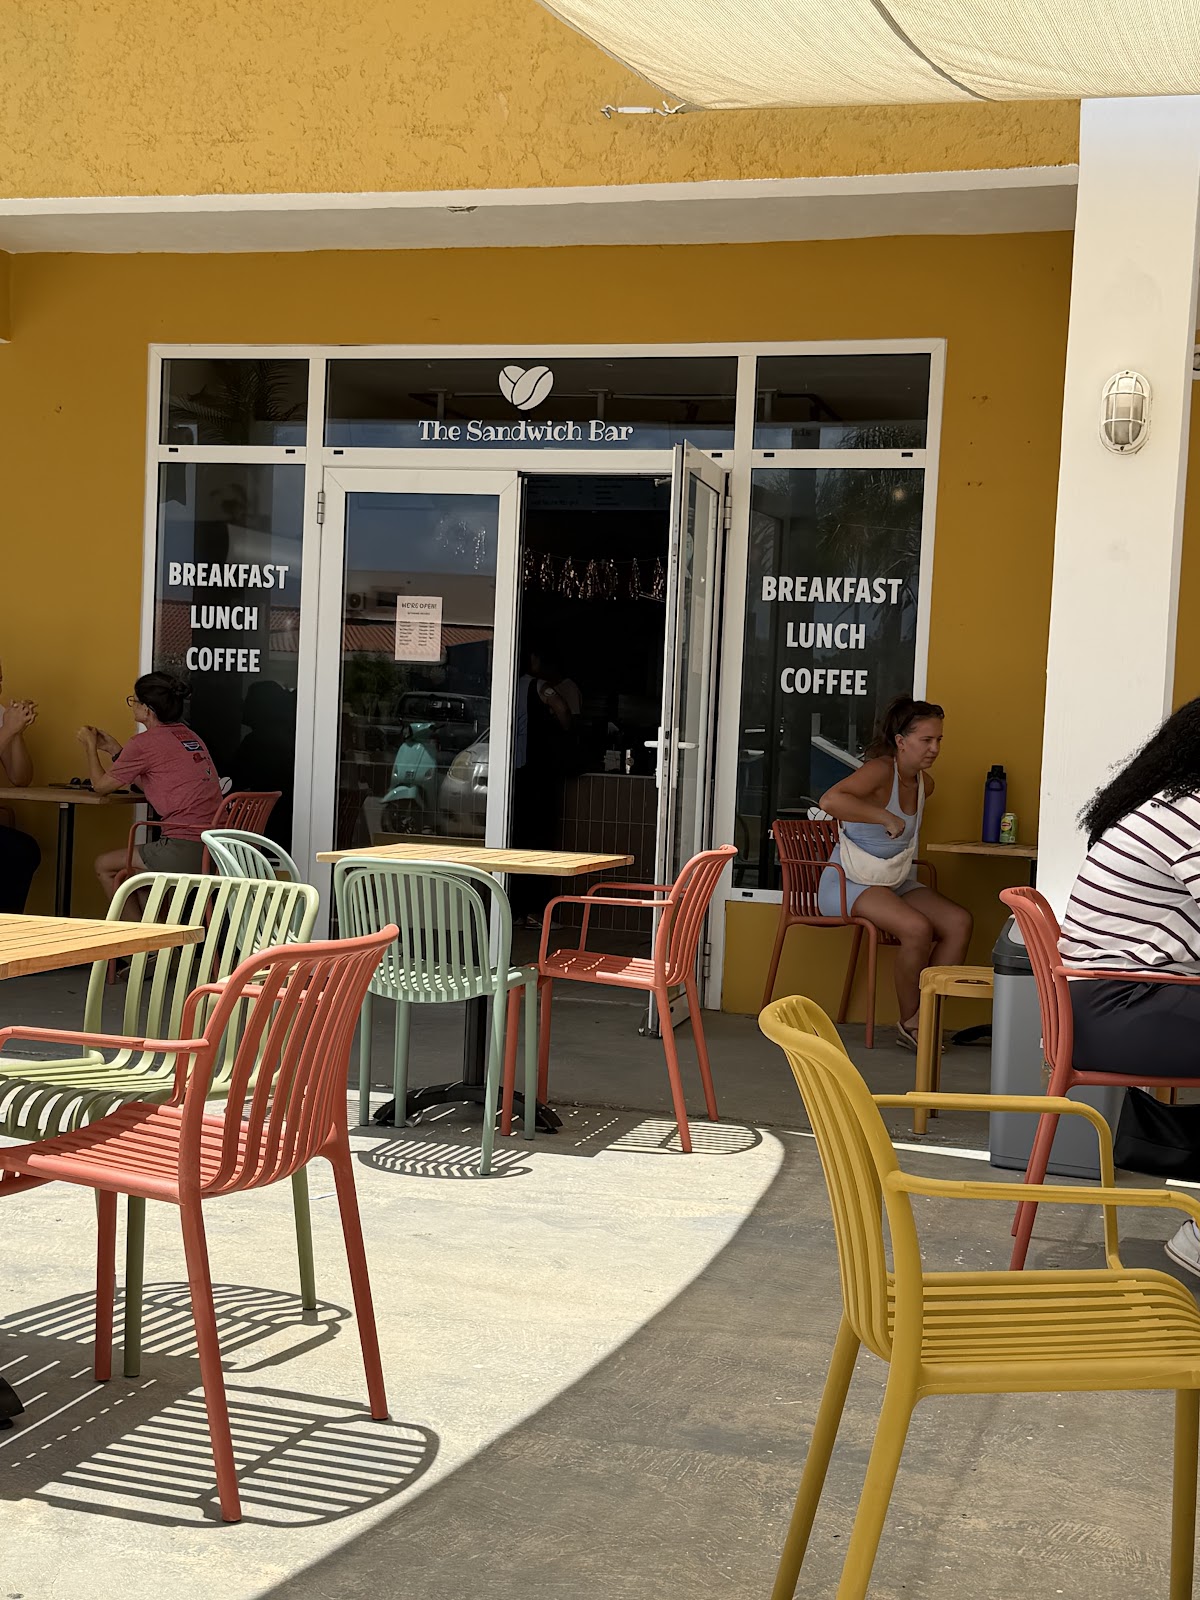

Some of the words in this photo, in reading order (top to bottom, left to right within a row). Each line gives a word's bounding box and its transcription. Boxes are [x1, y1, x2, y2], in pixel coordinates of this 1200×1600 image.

[418, 420, 460, 440] The
[467, 420, 582, 441] Sandwich
[588, 420, 633, 441] Bar
[169, 562, 288, 588] BREAKFAST
[762, 576, 902, 605] BREAKFAST
[191, 605, 257, 630] LUNCH
[787, 622, 865, 649] LUNCH
[187, 647, 260, 672] COFFEE
[781, 668, 867, 695] COFFEE
